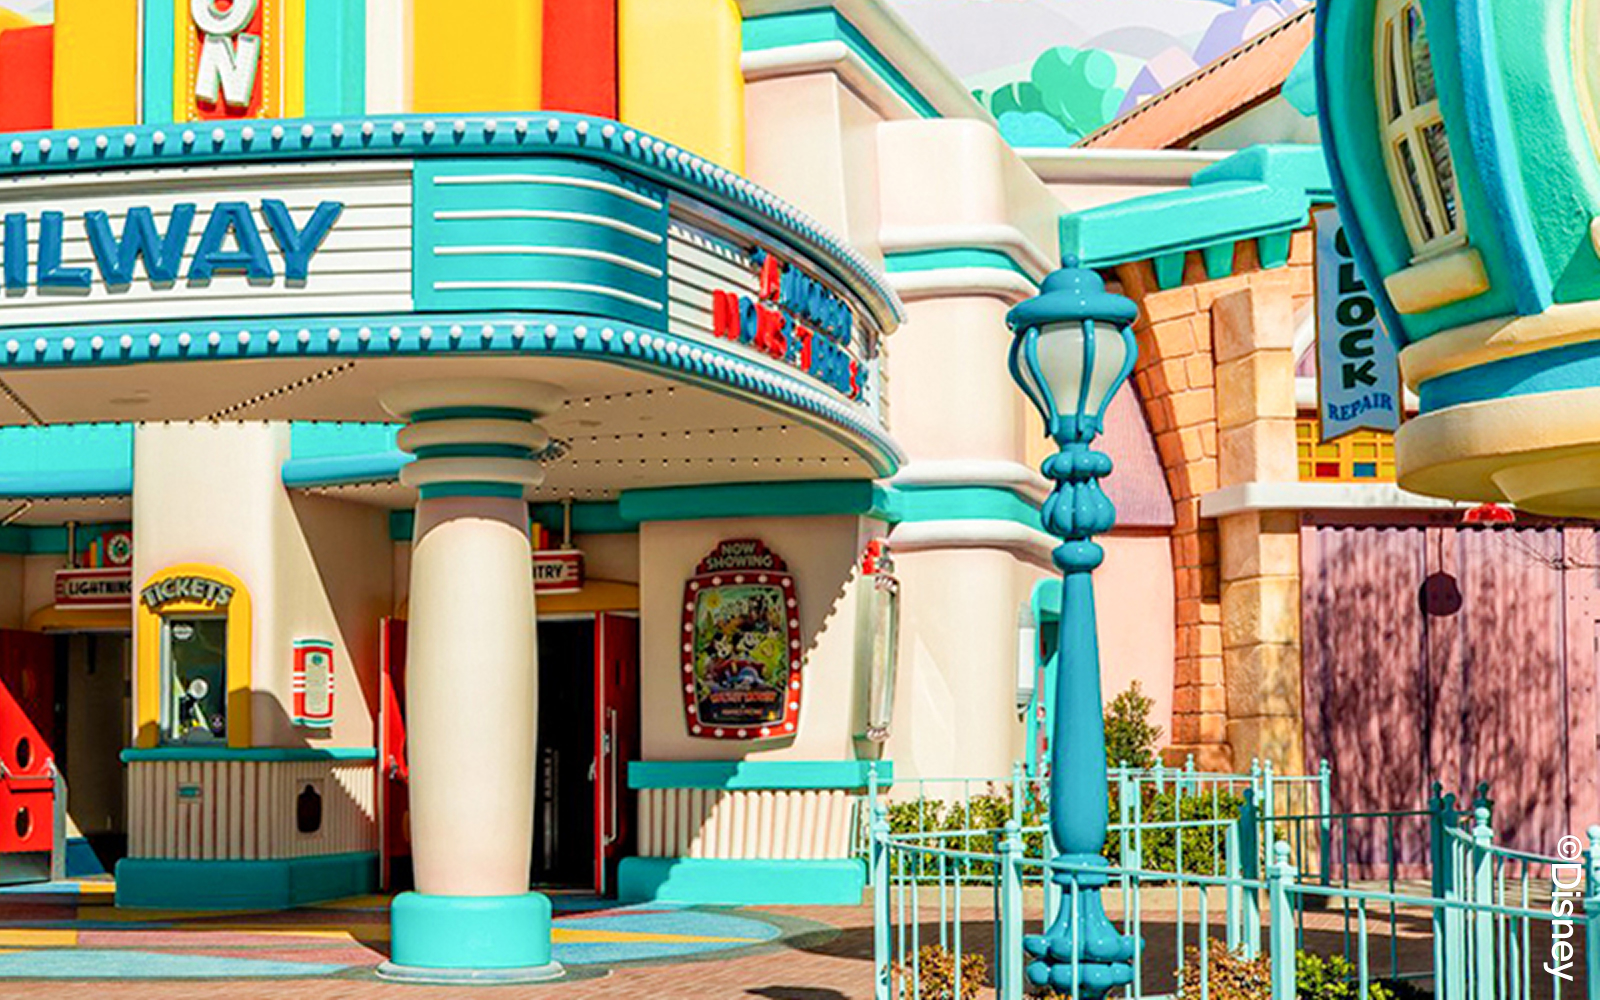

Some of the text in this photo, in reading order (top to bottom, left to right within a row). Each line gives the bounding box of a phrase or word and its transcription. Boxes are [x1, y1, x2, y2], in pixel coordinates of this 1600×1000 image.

[1327, 392, 1393, 422] REPAIR
[721, 542, 757, 555] NOW
[705, 554, 774, 571] SHOWING
[140, 576, 235, 608] TICKETS
